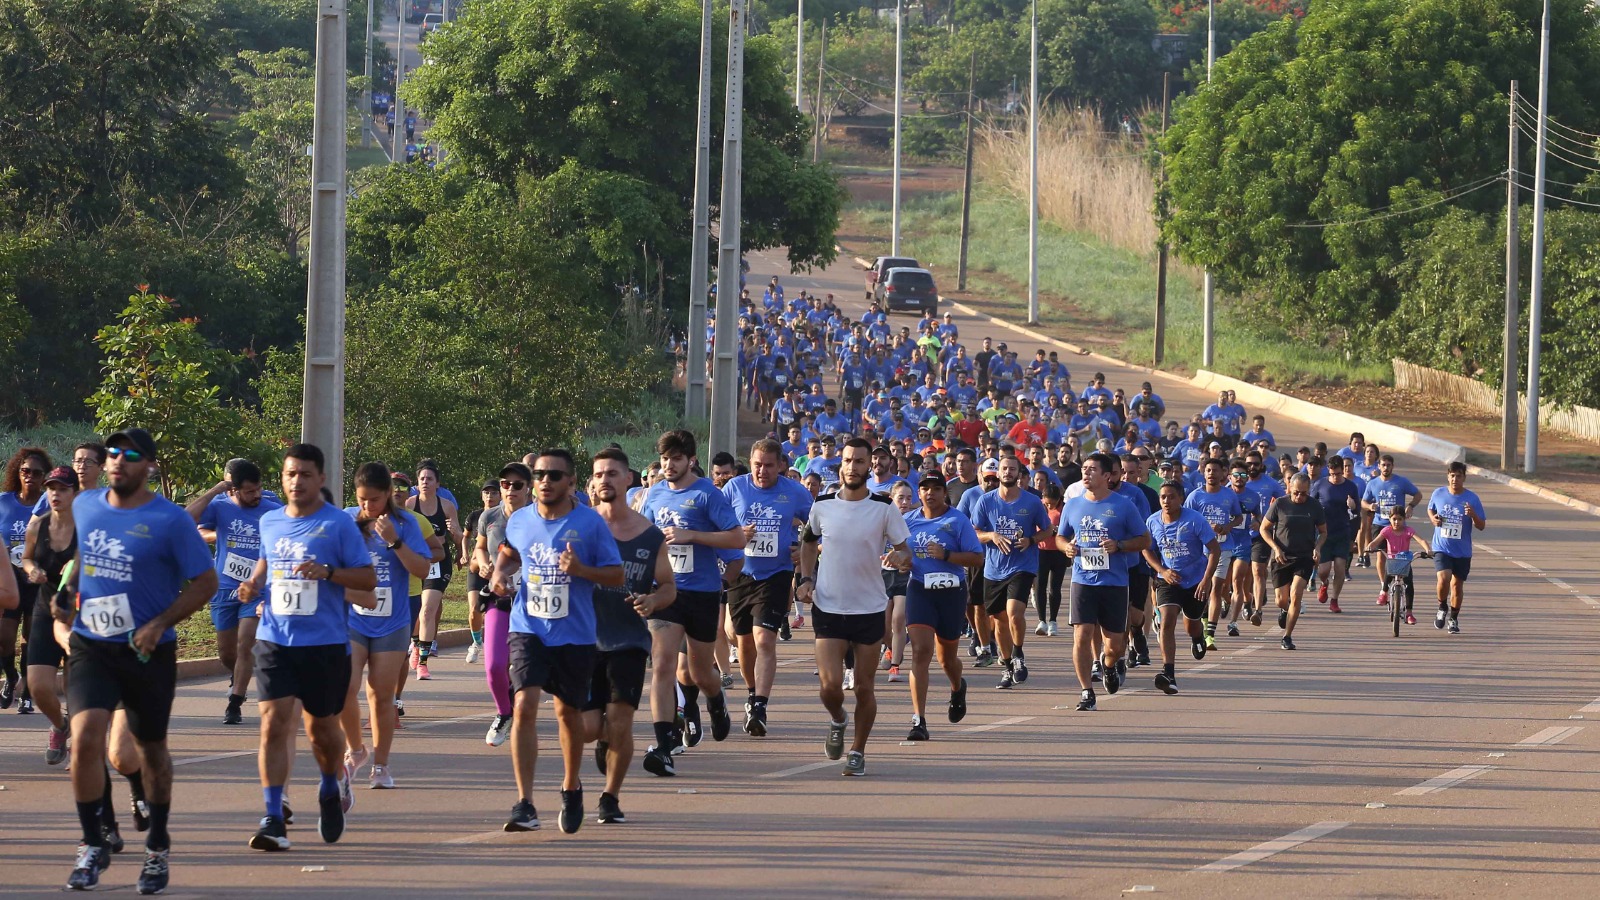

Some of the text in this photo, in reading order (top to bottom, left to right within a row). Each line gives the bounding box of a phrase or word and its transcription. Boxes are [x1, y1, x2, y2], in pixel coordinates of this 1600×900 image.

[1445, 528, 1458, 537] 112
[750, 540, 773, 553] 746
[83, 554, 133, 573] CORRIDA
[671, 554, 687, 569] 77
[1084, 554, 1105, 567] 808
[229, 561, 252, 579] 980
[623, 560, 647, 581] RPH
[283, 590, 302, 610] 91
[532, 595, 562, 614] 819
[89, 607, 125, 633] 196
